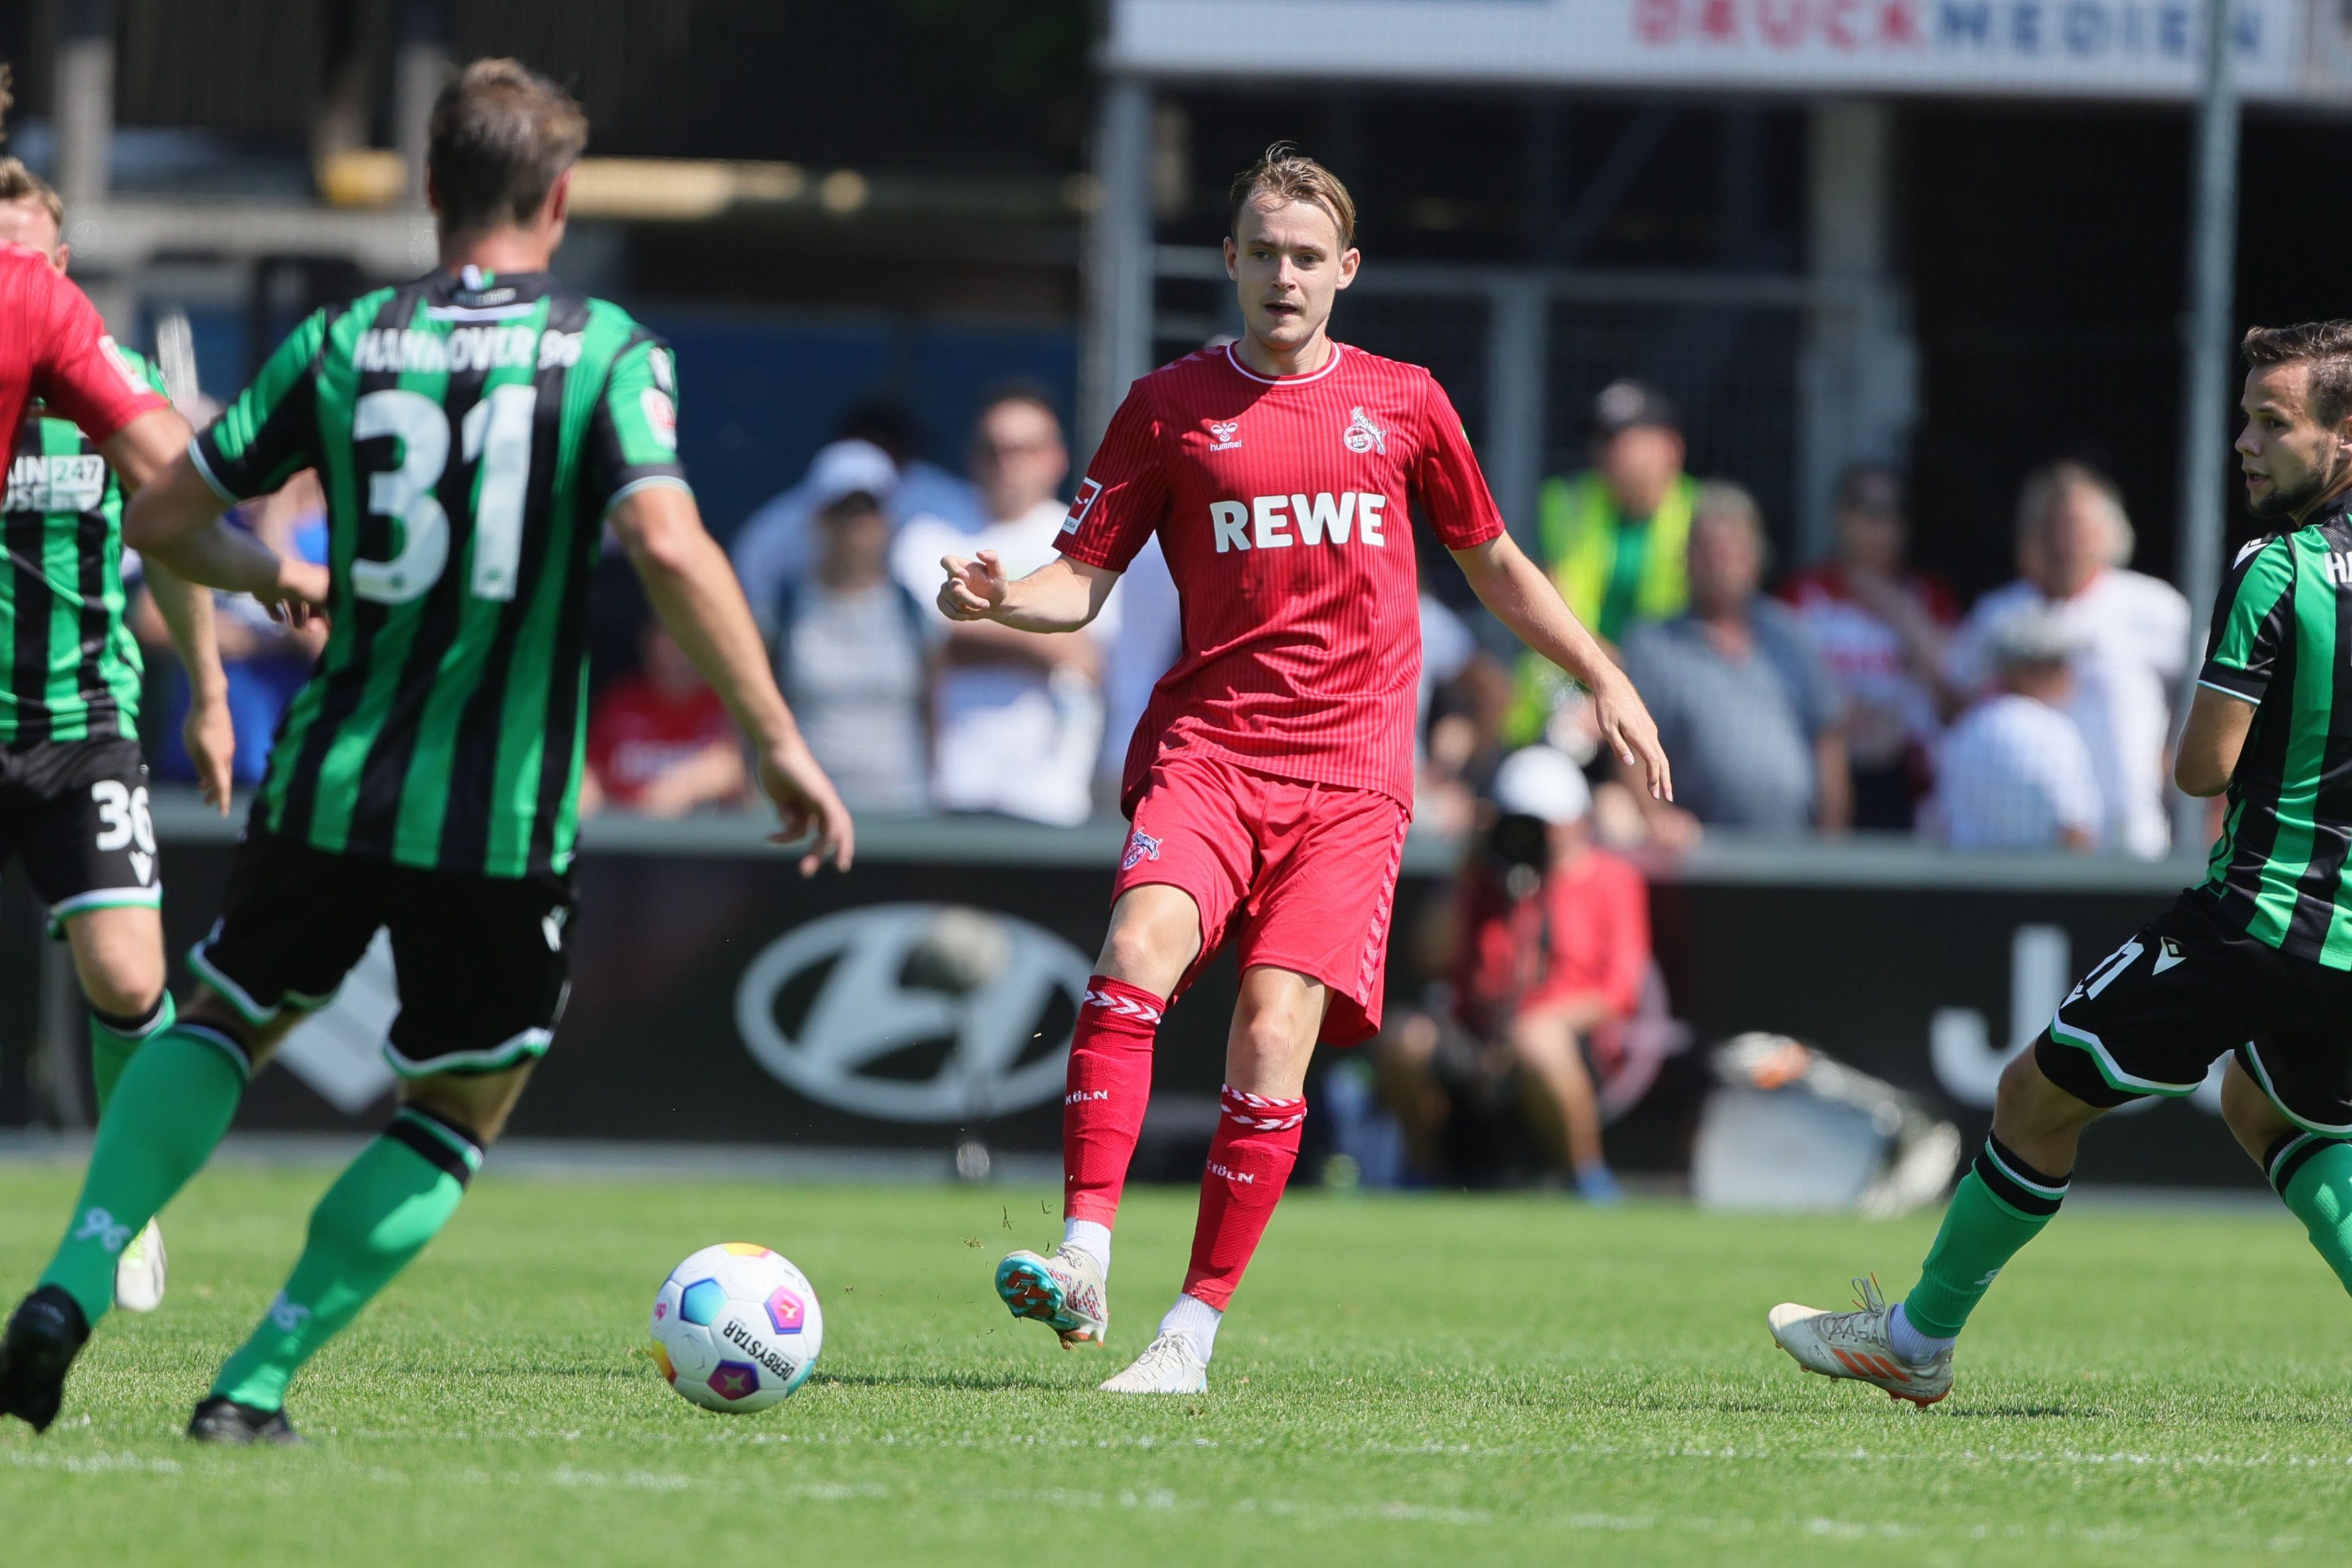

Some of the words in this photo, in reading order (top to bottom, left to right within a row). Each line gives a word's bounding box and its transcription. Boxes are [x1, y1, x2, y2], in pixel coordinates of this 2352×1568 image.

[353, 326, 537, 372] HANNOVER
[537, 329, 584, 369] 96
[1210, 439, 1242, 452] hummel
[352, 384, 538, 605] 31
[1209, 491, 1386, 553] REWE
[1065, 1089, 1109, 1106] KÖLN
[1212, 1164, 1255, 1184] KÖLN
[722, 1320, 795, 1381] DERBYSTAR
